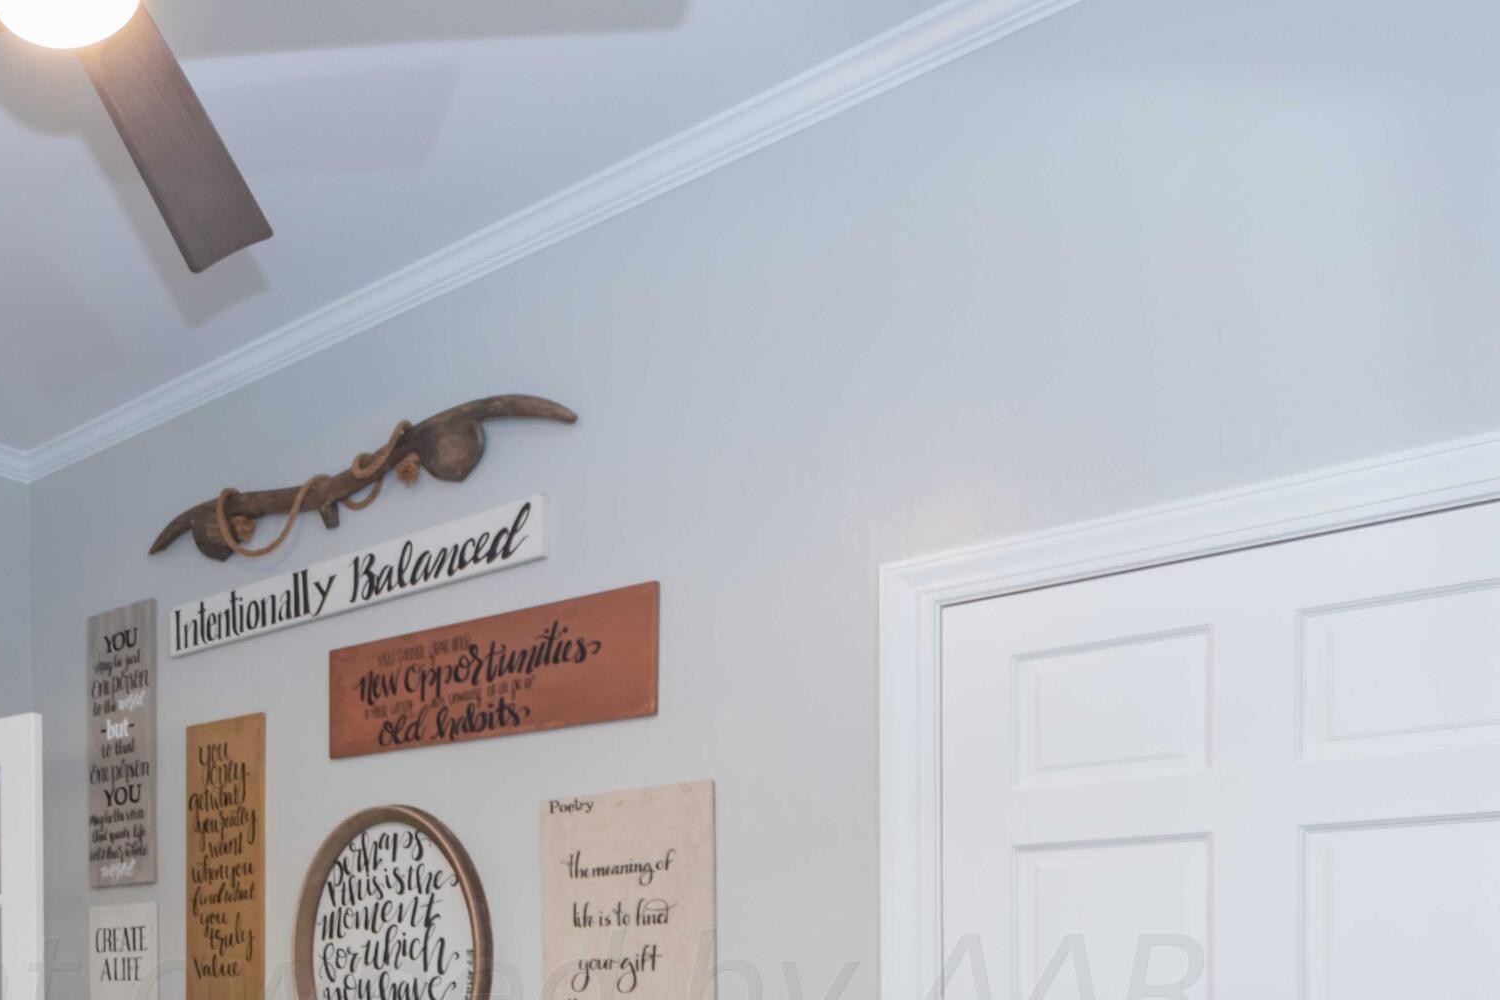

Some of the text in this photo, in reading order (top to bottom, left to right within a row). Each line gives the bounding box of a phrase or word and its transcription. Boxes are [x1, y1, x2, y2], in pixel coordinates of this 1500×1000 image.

[174, 501, 532, 652] Intentionally Balanced
[103, 627, 138, 653] YOU
[404, 620, 602, 701] opportunities
[378, 706, 428, 747] old
[430, 696, 531, 742] habits
[103, 784, 142, 807] YOU
[550, 798, 595, 814] Poetry
[208, 832, 242, 857] want
[328, 831, 432, 900] perhaps
[561, 849, 676, 887] the meaning of
[200, 912, 228, 938] you
[318, 892, 444, 941] moment
[573, 898, 678, 928] life is to find
[95, 925, 148, 953] CREATE
[320, 942, 362, 984] for
[361, 924, 460, 975] which
[100, 956, 143, 982] A LIFE
[571, 944, 664, 994] your gift
